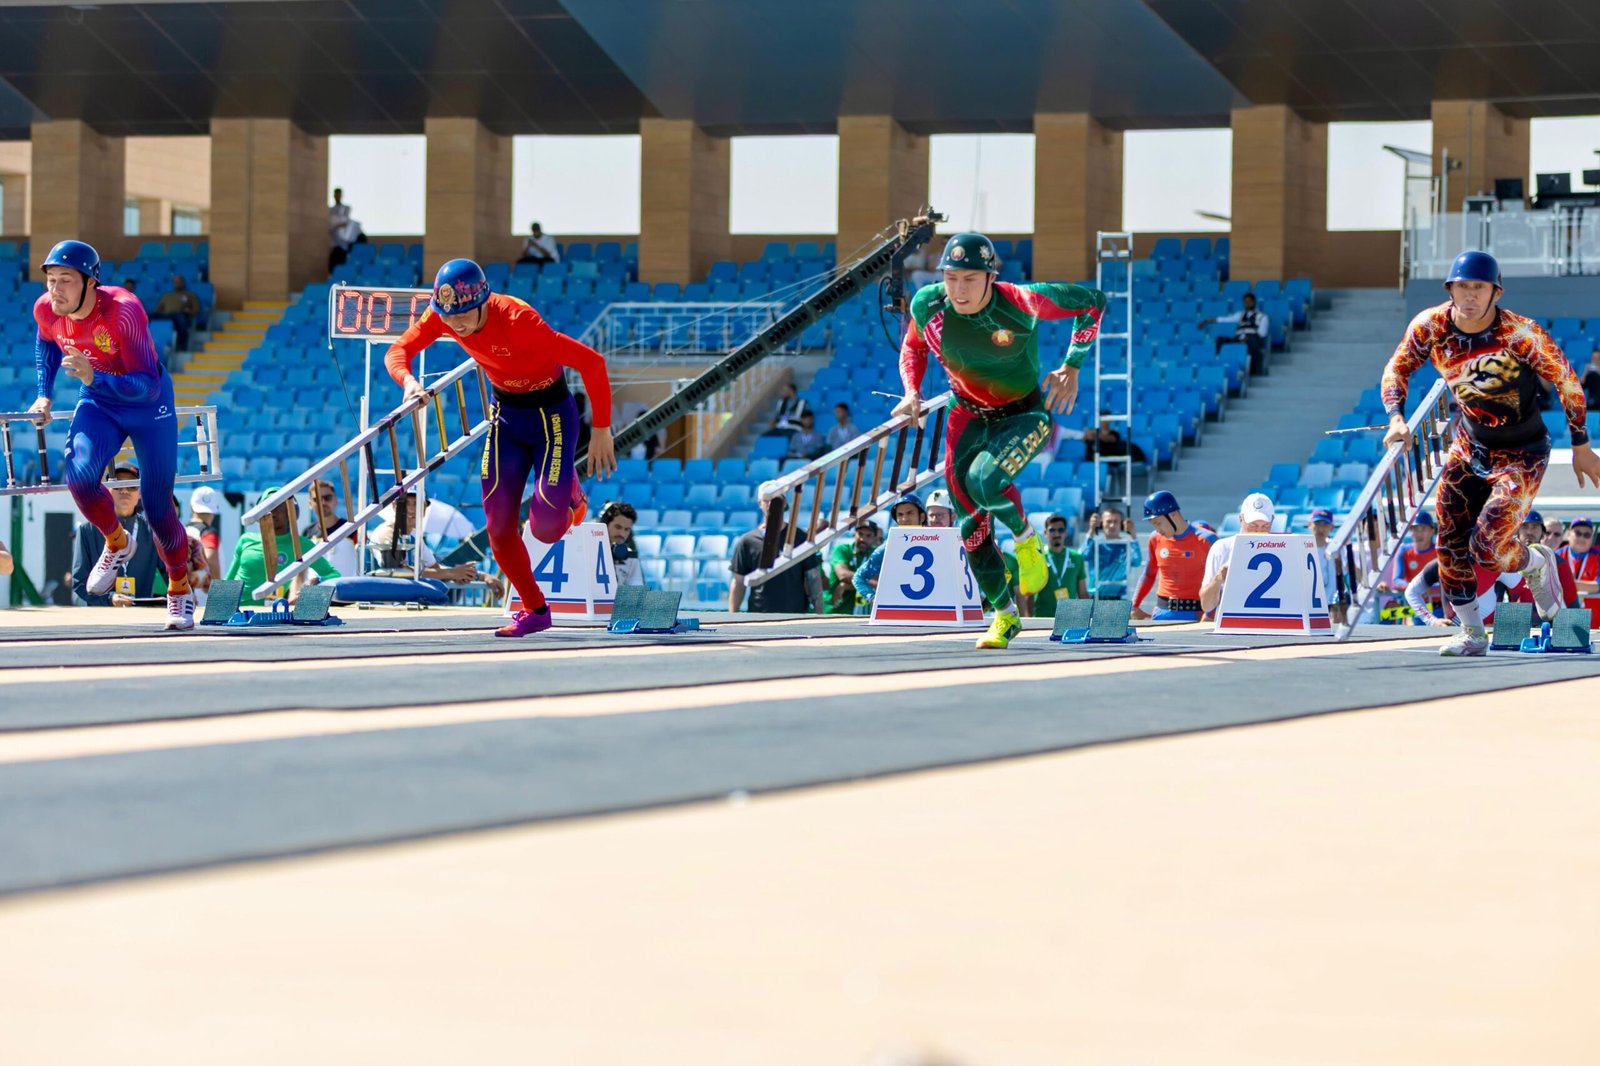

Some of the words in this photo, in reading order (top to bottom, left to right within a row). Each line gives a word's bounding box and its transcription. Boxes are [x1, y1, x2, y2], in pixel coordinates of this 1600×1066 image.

[552, 446, 562, 459] AND
[553, 432, 563, 446] FIRE
[548, 458, 562, 483] RESCUE
[910, 534, 940, 542] polanik
[1257, 541, 1286, 549] polanik
[533, 539, 569, 593] 4
[596, 541, 610, 594] 4
[900, 545, 935, 600] 3
[960, 546, 973, 600] 3
[1243, 552, 1283, 608] 2
[1307, 553, 1322, 608] 2
